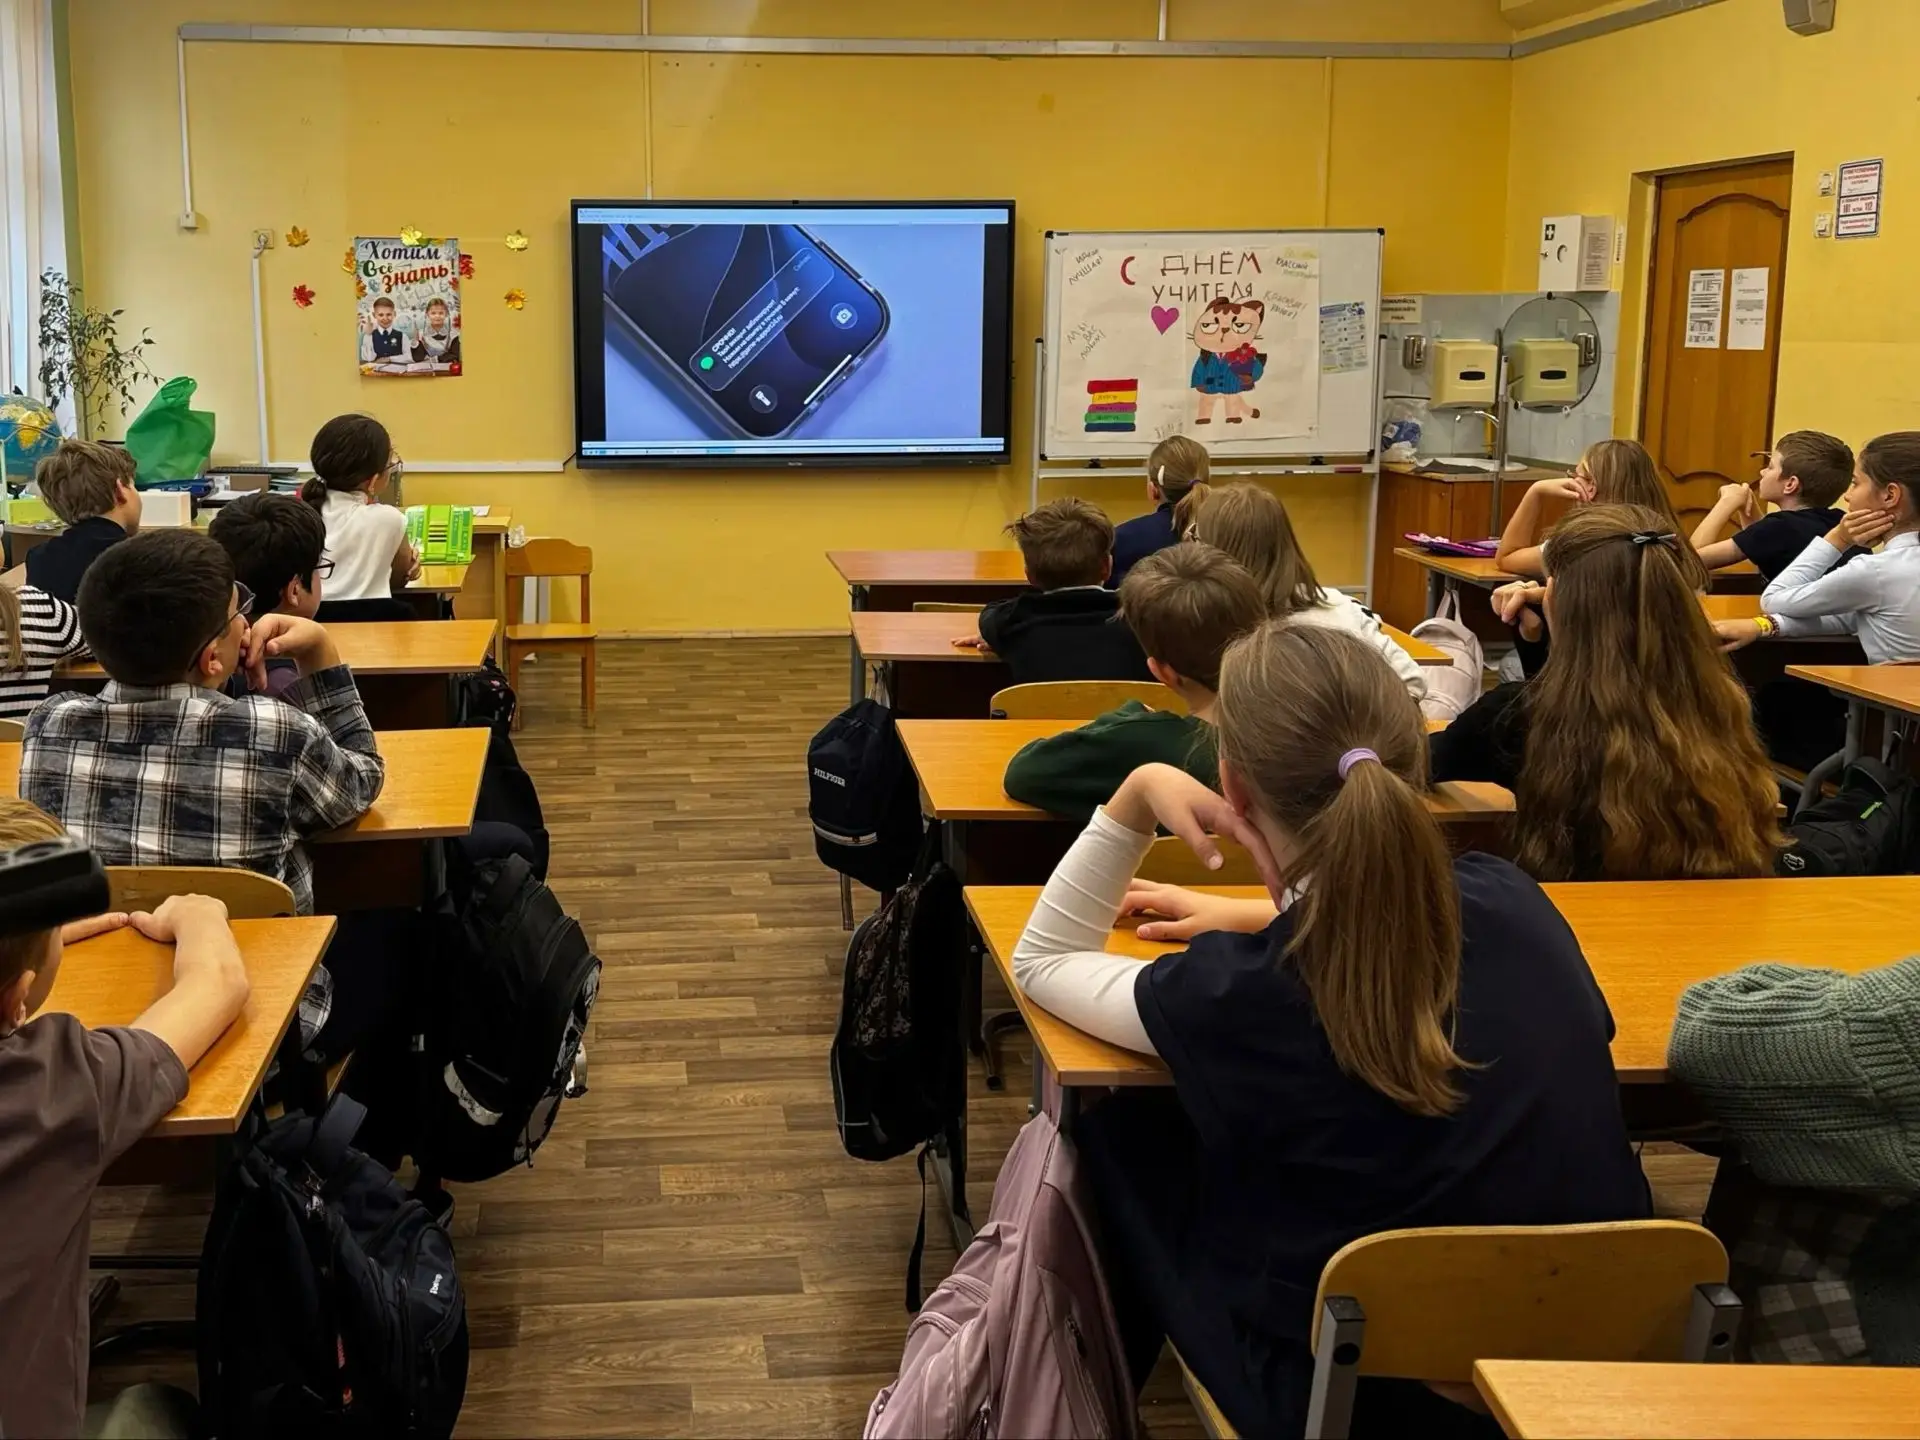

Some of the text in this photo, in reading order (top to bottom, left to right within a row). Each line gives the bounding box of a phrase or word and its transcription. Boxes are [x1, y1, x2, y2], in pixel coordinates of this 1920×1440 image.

[364, 240, 441, 261] Хотим
[1120, 255, 1136, 286] С
[1160, 251, 1262, 277] ДНЁМ
[1151, 281, 1253, 303] УЧИТЕЛЯ
[711, 327, 737, 353] СРОЧНО!
[813, 767, 846, 787] HILFIGER
